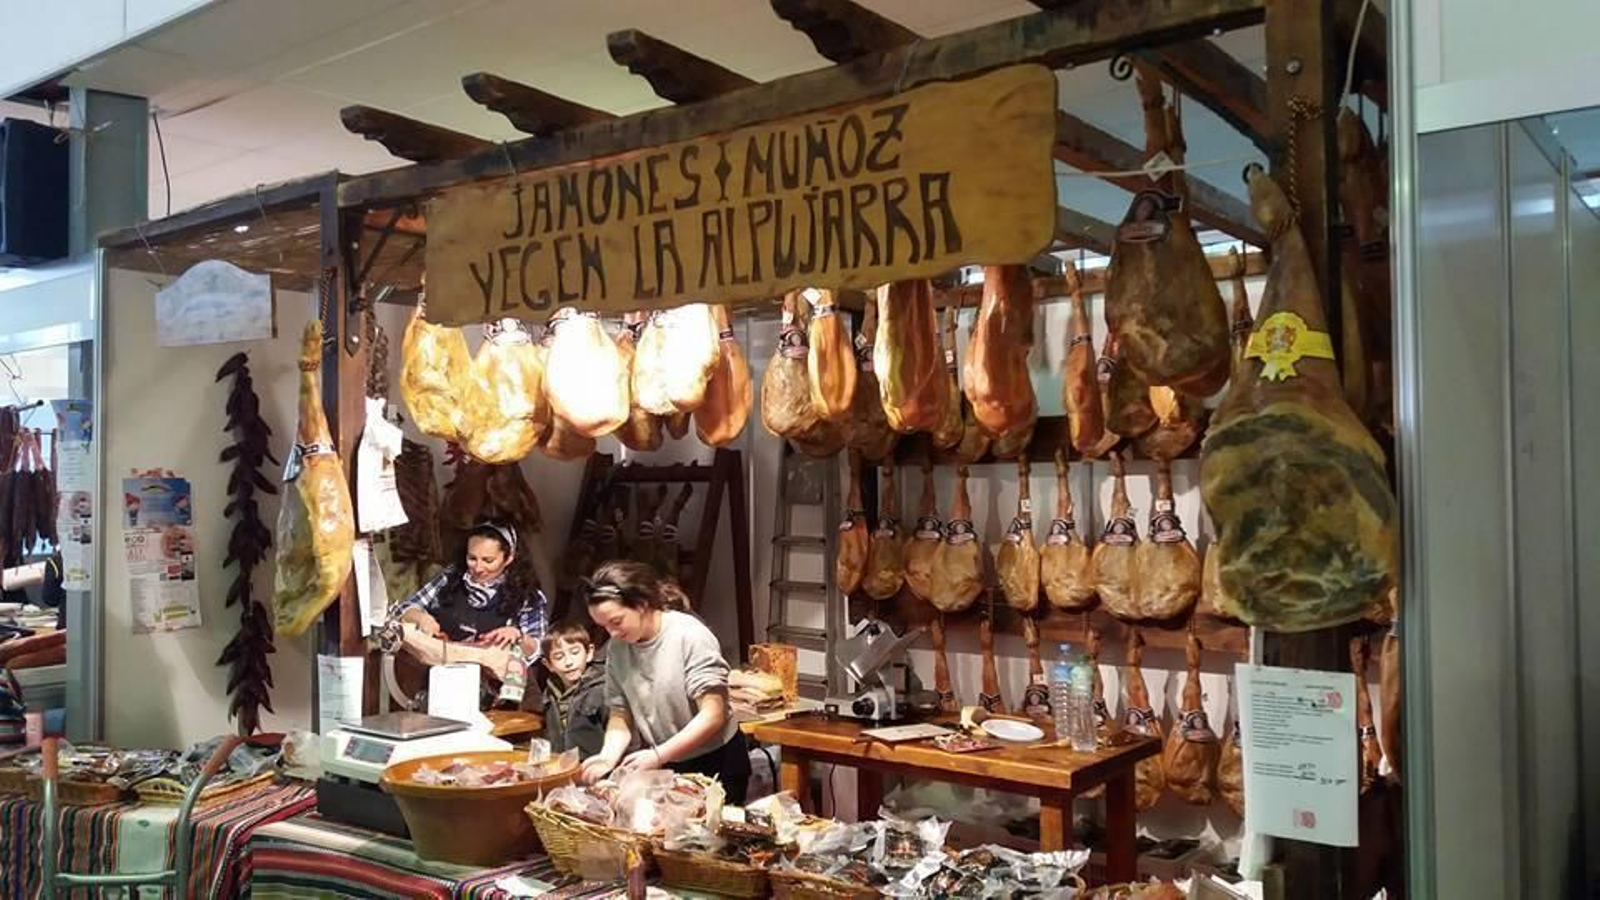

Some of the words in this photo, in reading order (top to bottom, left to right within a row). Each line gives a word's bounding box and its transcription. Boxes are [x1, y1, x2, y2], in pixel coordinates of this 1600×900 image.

[503, 145, 700, 239] JAMONES
[743, 103, 909, 197] MUÑOZ
[469, 232, 606, 315] YEGEN
[634, 219, 684, 299] LA
[699, 171, 962, 288] ALPUJARRA
